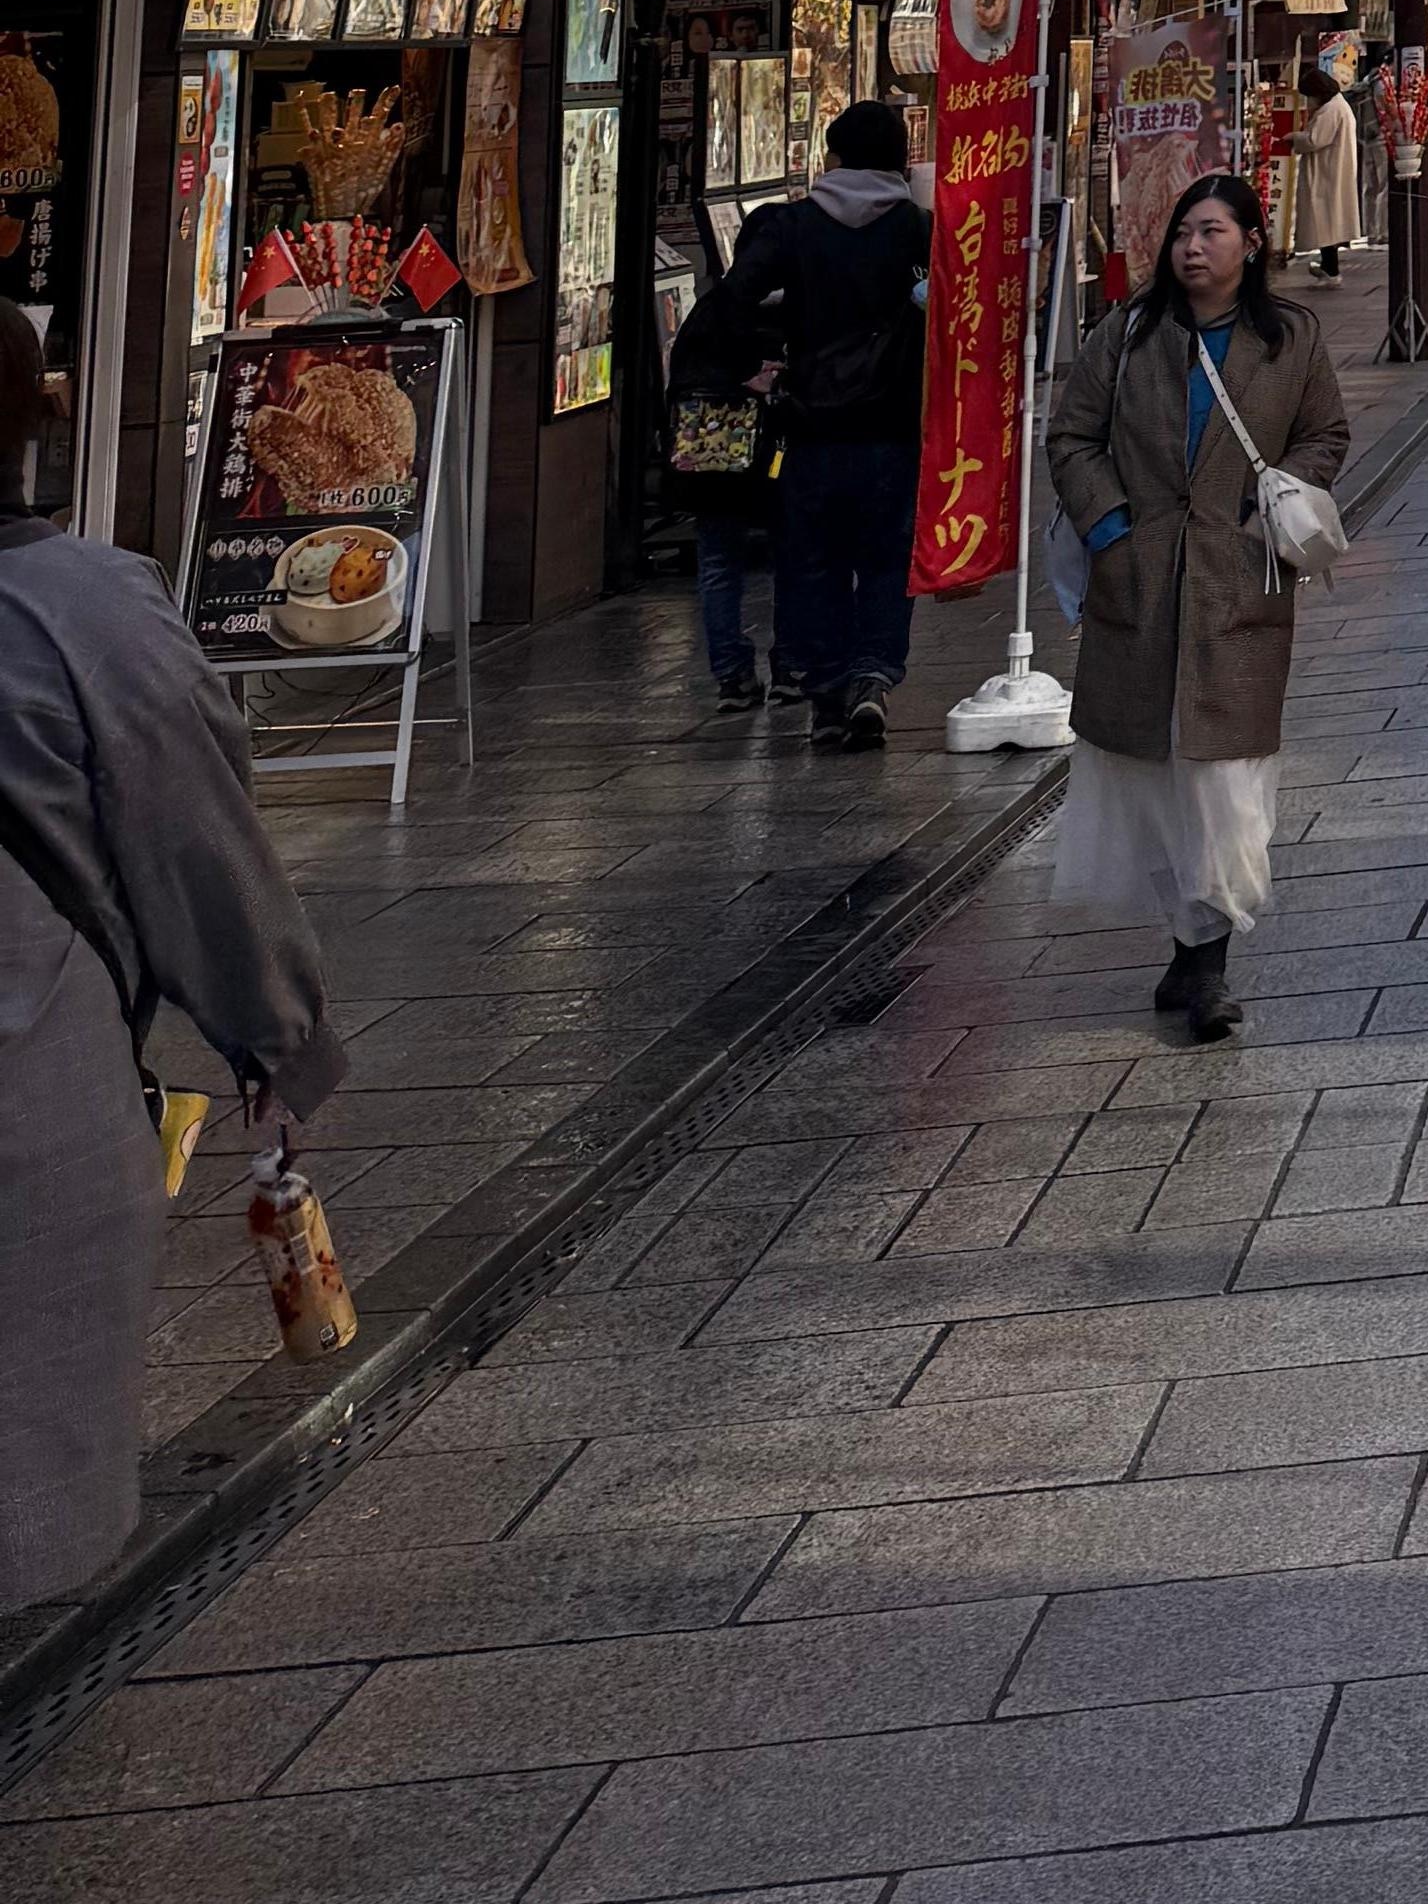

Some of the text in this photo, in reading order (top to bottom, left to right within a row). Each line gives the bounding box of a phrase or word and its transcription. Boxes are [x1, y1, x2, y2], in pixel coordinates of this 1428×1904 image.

[28, 199, 54, 294] 唐揚げ串
[220, 362, 259, 499] 中華街大鶏排
[934, 200, 988, 577] 台湾ドーナツ
